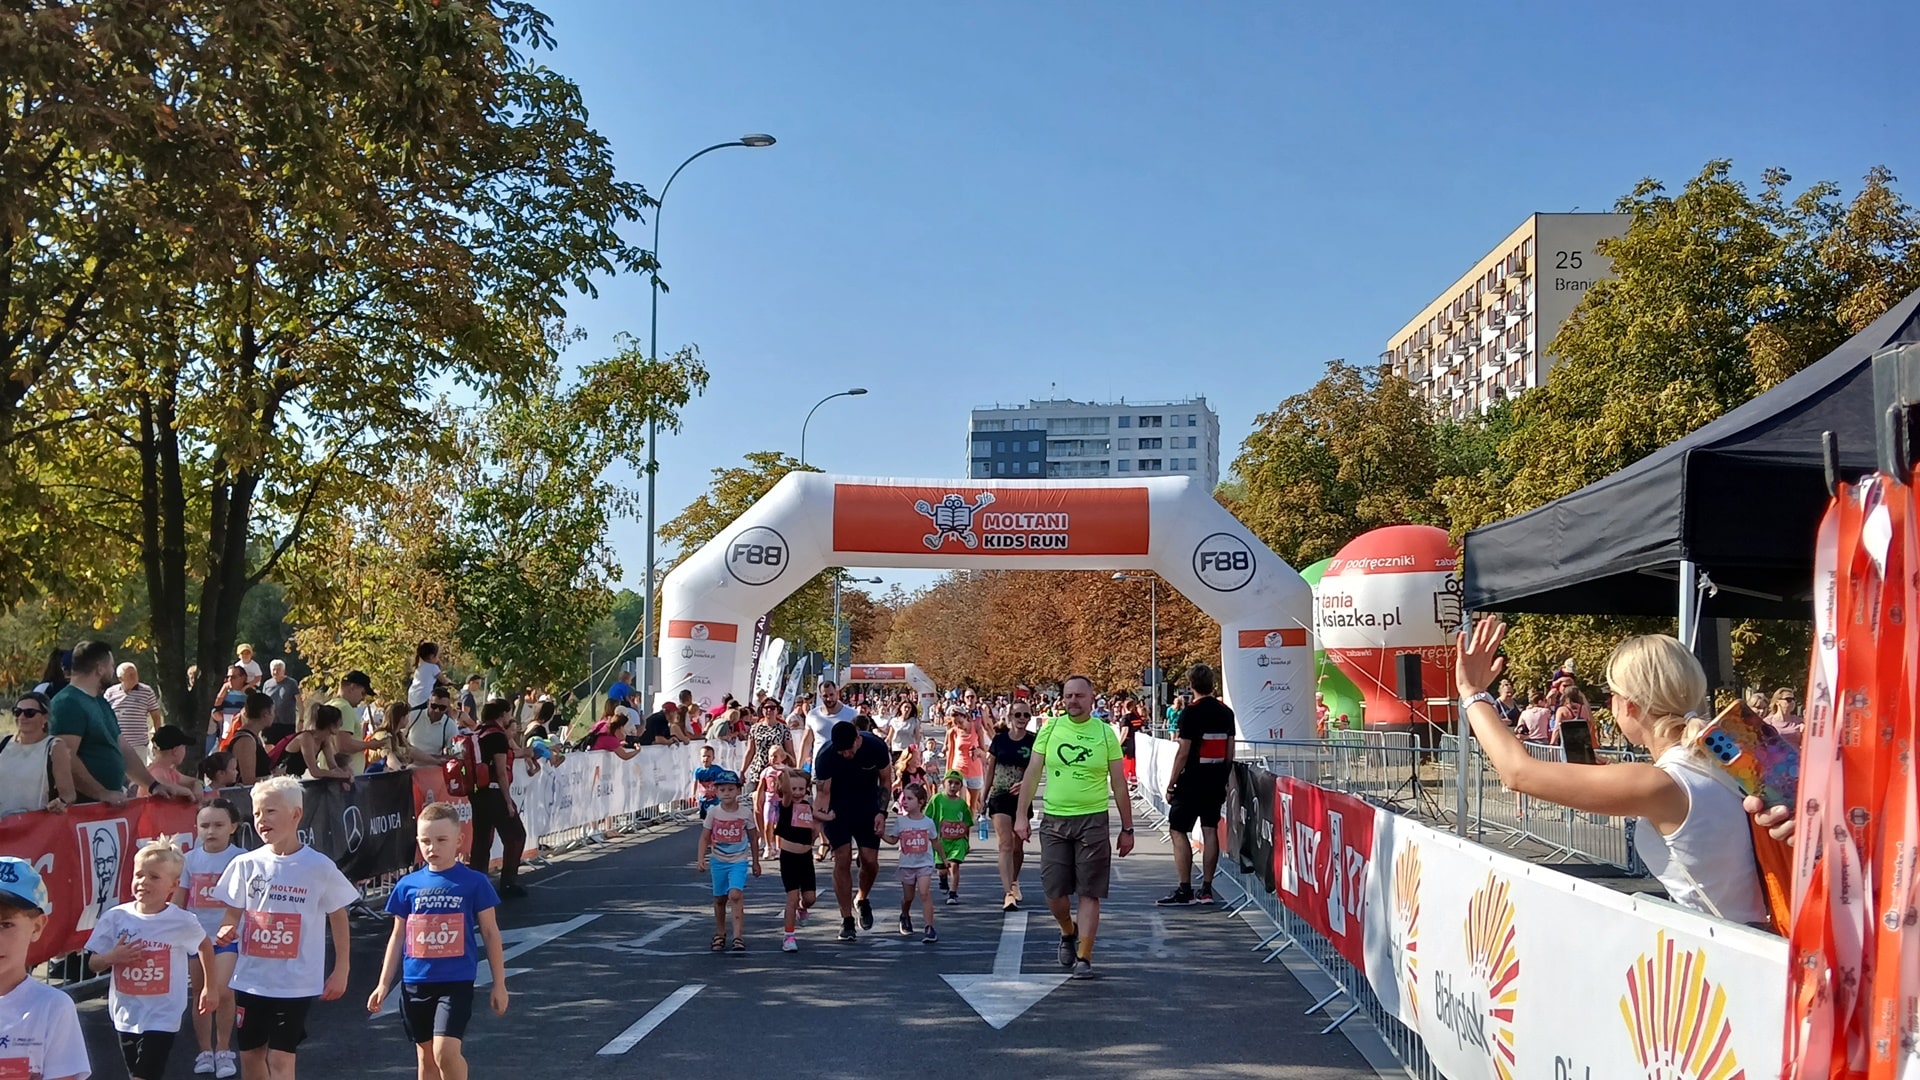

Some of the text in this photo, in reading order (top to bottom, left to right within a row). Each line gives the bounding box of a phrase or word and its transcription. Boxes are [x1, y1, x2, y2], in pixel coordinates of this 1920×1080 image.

[1556, 251, 1583, 269] 25
[984, 514, 1068, 529] MOLTANI
[984, 534, 1067, 548] KIDS RUN
[1346, 555, 1415, 569] podręczniki
[1434, 558, 1458, 567] zaba
[1322, 592, 1353, 608] tania
[1322, 607, 1401, 630] ksiazka.pl
[369, 816, 388, 835] AUTO
[717, 828, 740, 836] 4063
[271, 885, 307, 895] MOLTANI
[269, 894, 306, 903] KIDS RUN
[251, 928, 294, 945] 4036
[416, 930, 459, 944] 4407
[141, 940, 172, 950] OLTANI
[122, 966, 164, 981] 4035
